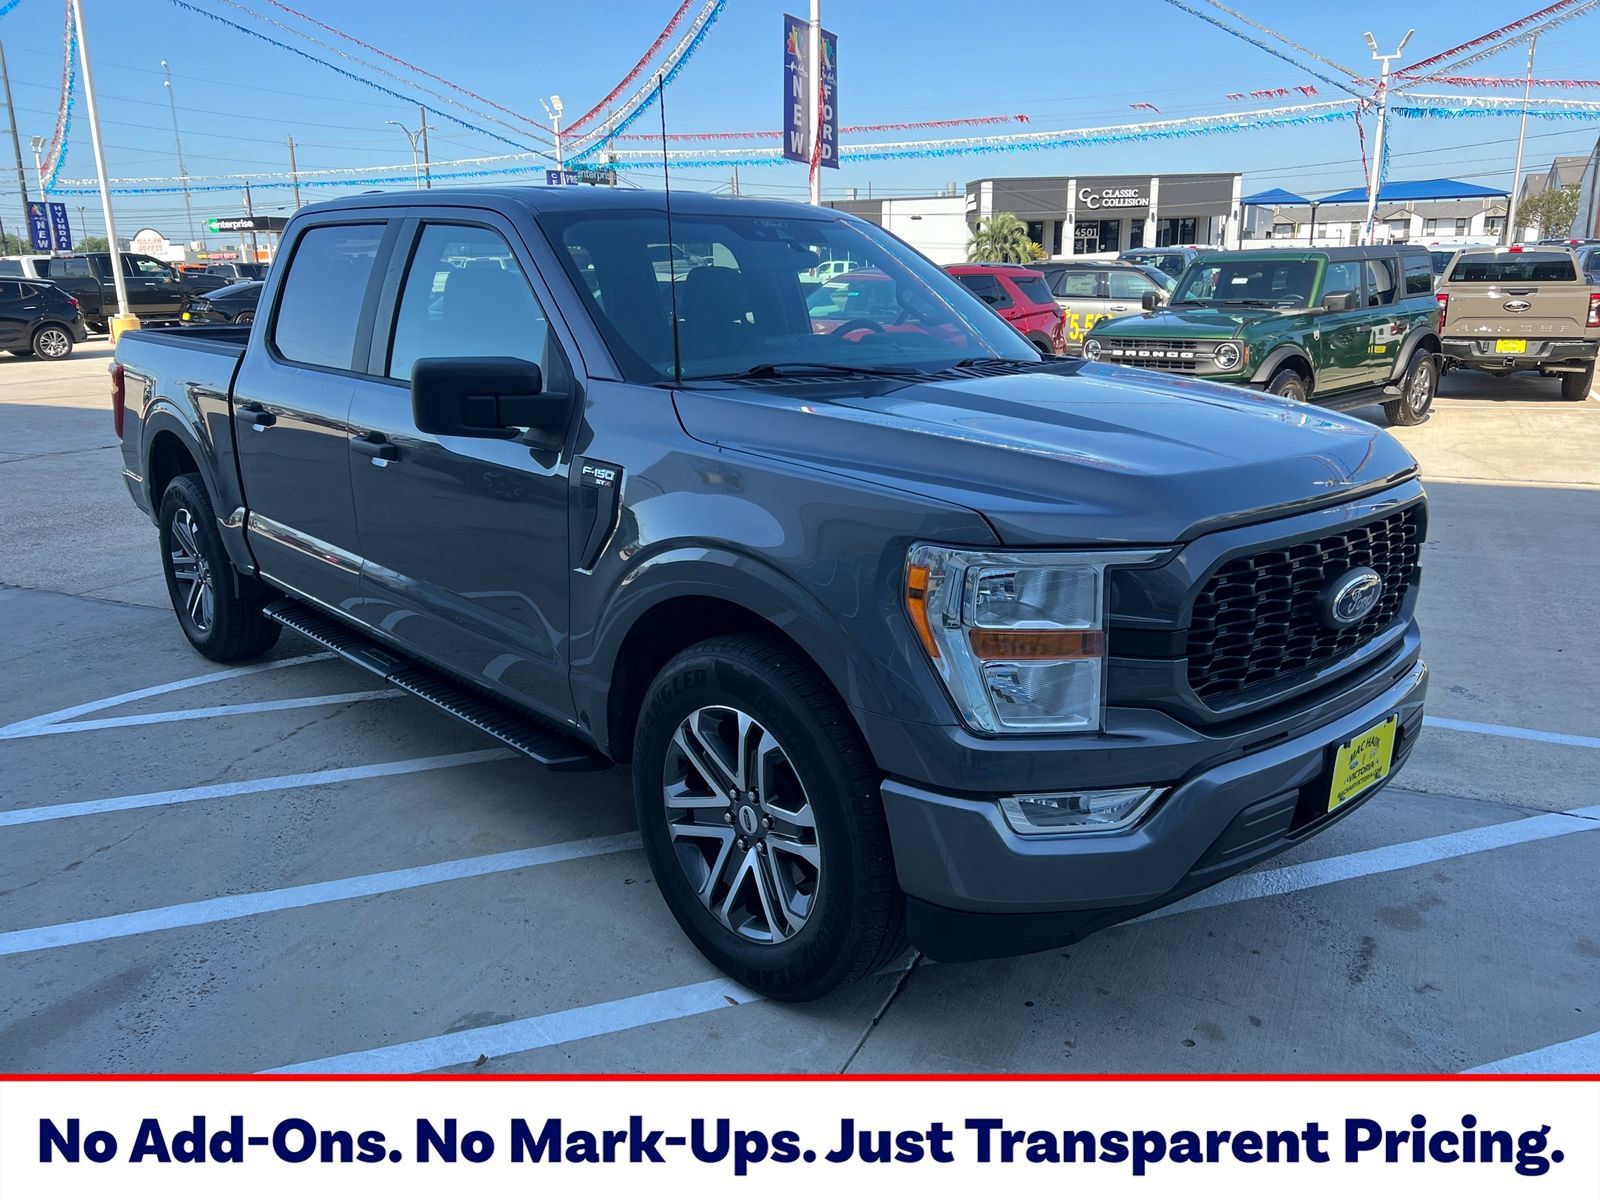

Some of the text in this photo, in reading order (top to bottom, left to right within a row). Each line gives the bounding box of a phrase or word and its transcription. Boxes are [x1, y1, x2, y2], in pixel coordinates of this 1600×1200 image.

[791, 75, 803, 154] NEW
[822, 84, 832, 160] FORD
[1102, 189, 1139, 197] CLASSIC
[1102, 198, 1149, 206] COLLISION
[53, 205, 67, 248] HYUNDAI
[209, 219, 254, 230] enterprise
[36, 220, 49, 248] NEW
[1075, 228, 1097, 237] 4501
[1112, 350, 1194, 358] BRONCO
[582, 466, 615, 480] F-150
